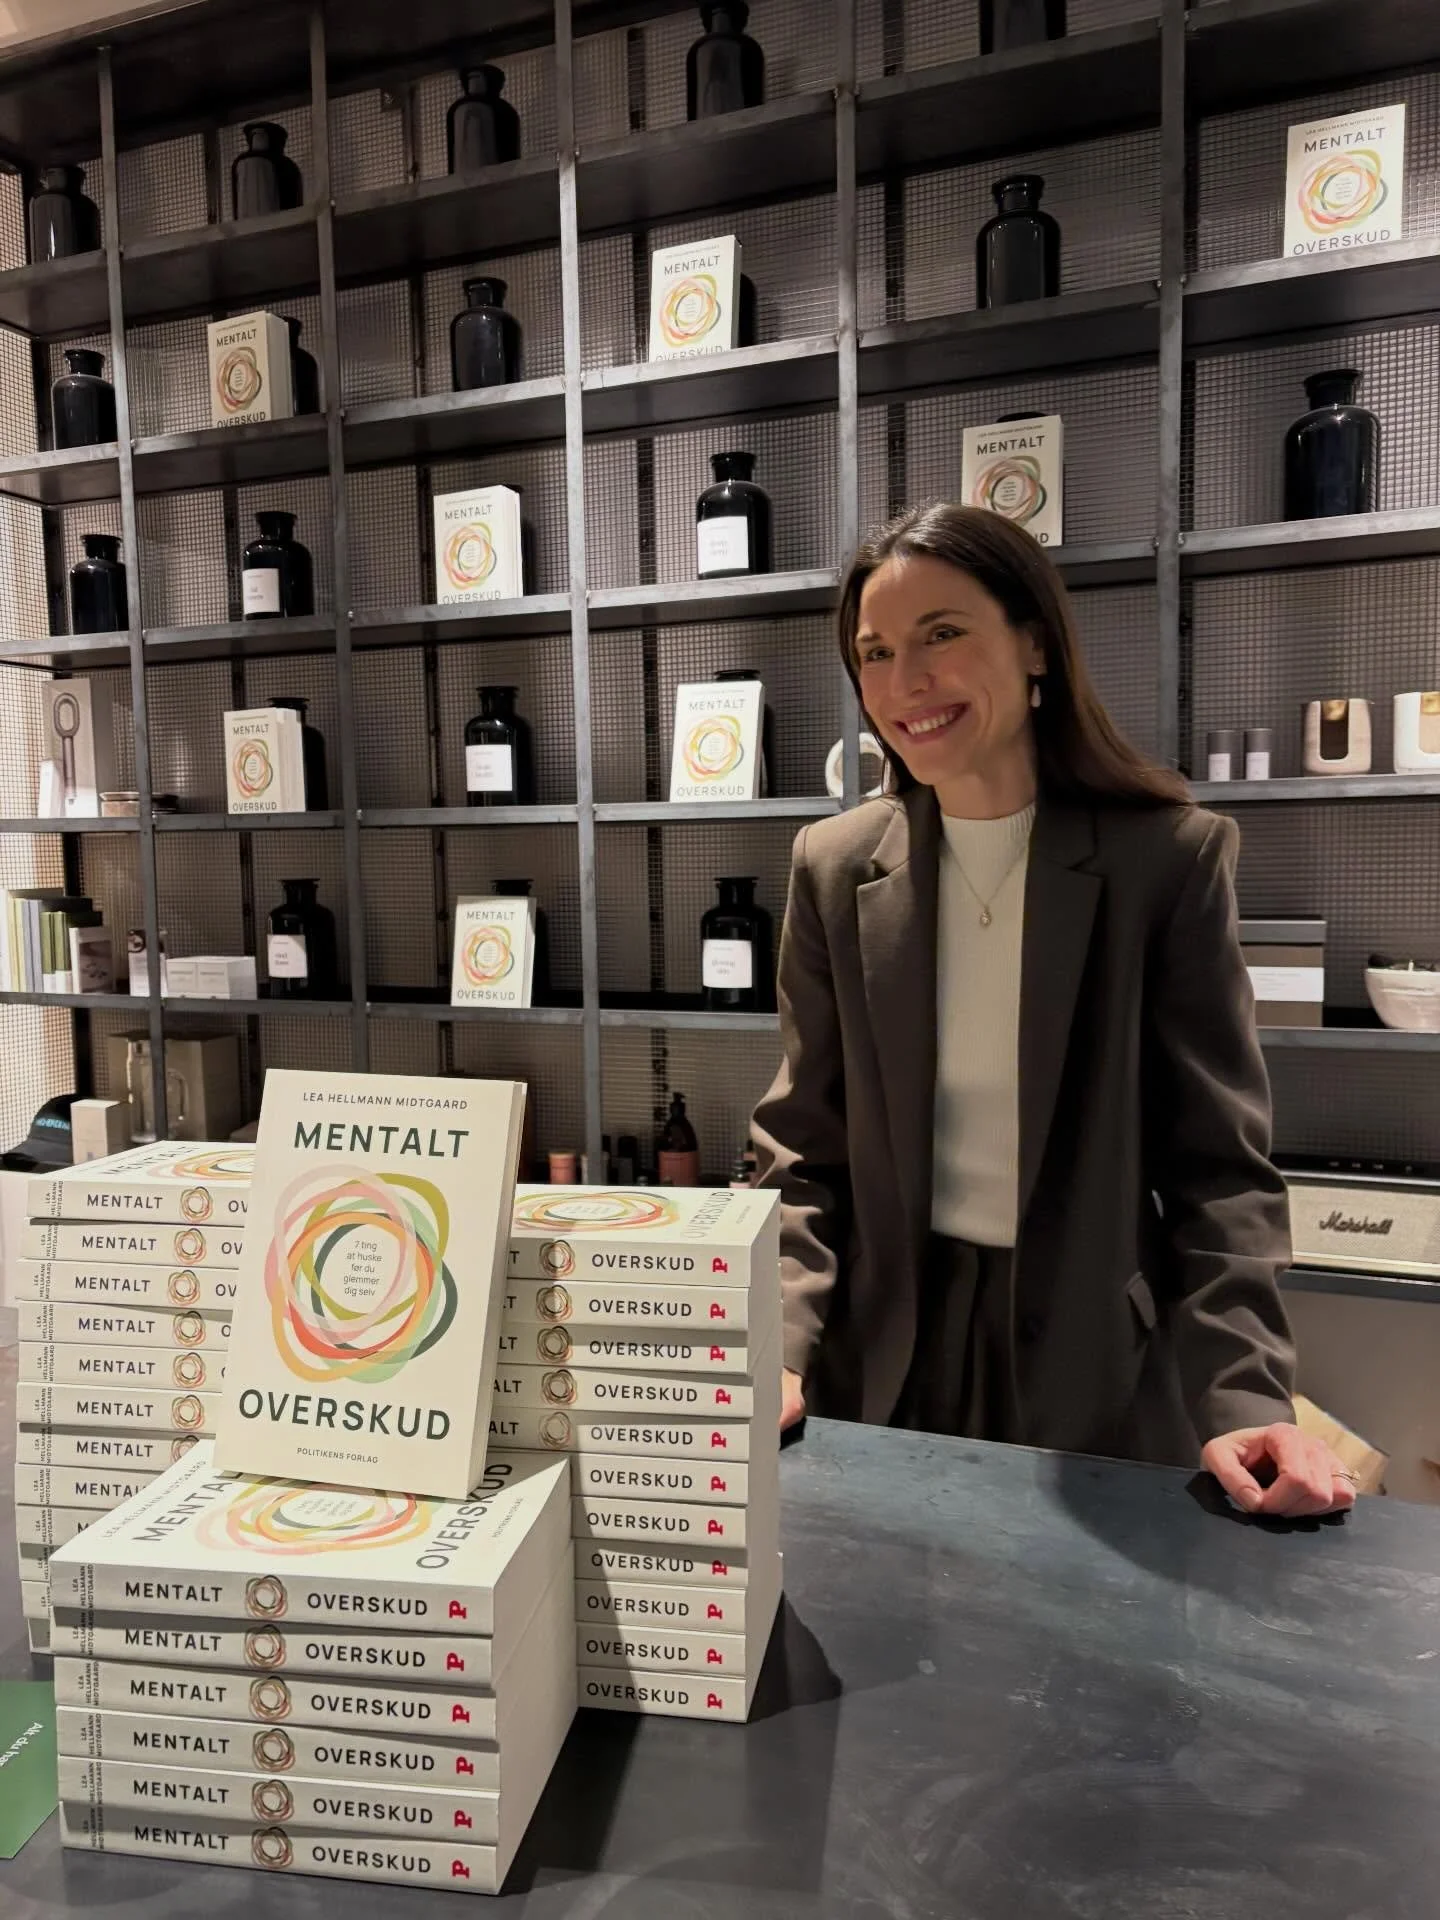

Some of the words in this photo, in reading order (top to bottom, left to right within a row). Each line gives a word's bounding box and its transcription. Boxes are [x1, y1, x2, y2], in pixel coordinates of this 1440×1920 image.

[1304, 128, 1386, 154] MENTALT
[1293, 230, 1391, 256] OVERSKUD
[664, 256, 721, 276] MENTALT
[216, 329, 257, 348] MENTALT
[977, 436, 1045, 456] MENTALT
[445, 504, 493, 521] MENTALT
[689, 698, 746, 711] MENTALT
[233, 724, 269, 735] MENTALT
[676, 786, 745, 797] OVERSKUD
[232, 802, 277, 812] OVERSKUD
[466, 911, 516, 921] MENTALT
[458, 990, 516, 1001] OVERSKUD
[303, 1092, 324, 1102] LEA
[328, 1093, 392, 1106] HELLMANN
[396, 1098, 468, 1110] MIDTGAARD
[294, 1122, 470, 1158] MENTALT
[87, 1194, 163, 1209] MENTALT
[682, 1192, 735, 1238] OVERSKUD
[1319, 1210, 1394, 1235] Marshall
[82, 1236, 157, 1251] MENTALT
[354, 1240, 360, 1249] 7
[362, 1241, 378, 1253] ting
[346, 1252, 356, 1260] at
[358, 1252, 383, 1262] huske
[592, 1254, 695, 1271] OVERSKUD
[352, 1264, 363, 1272] før
[364, 1264, 375, 1273] du
[75, 1276, 151, 1292] MENTALT
[344, 1274, 380, 1285] glemmer
[344, 1287, 357, 1297] dig
[358, 1288, 376, 1297] selv
[589, 1300, 692, 1317] OVERSKUD
[78, 1318, 156, 1333] MENTALT
[589, 1340, 692, 1359] OVERSKUD
[79, 1359, 156, 1375] MENTALT
[594, 1384, 697, 1402] OVERSKUD
[77, 1401, 154, 1417] MENTALT
[239, 1388, 451, 1441] OVERSKUD
[591, 1426, 693, 1445] OVERSKUD
[76, 1440, 153, 1458] MENTALT
[297, 1448, 344, 1460] POLITIKENS
[346, 1453, 379, 1464] FORLAG
[590, 1470, 693, 1489] OVERSKUD
[76, 1482, 145, 1498] MENTA
[132, 1472, 244, 1542] MENTAL
[416, 1464, 513, 1569] OVERSKUD
[587, 1512, 689, 1532] OVERSKUD
[592, 1554, 694, 1573] OVERSKUD
[125, 1582, 223, 1603] MENTALT
[307, 1593, 428, 1616] OVERSKUD
[587, 1596, 689, 1616] OVERSKUD
[125, 1628, 222, 1652] MENTALT
[306, 1644, 426, 1668] OVERSKUD
[586, 1640, 689, 1661] OVERSKUD
[130, 1680, 227, 1703] MENTALT
[311, 1695, 431, 1720] OVERSKUD
[586, 1682, 689, 1705] OVERSKUD
[23, 1722, 44, 1736] Alt
[10, 1737, 29, 1750] du
[134, 1732, 230, 1754] MENTALT
[314, 1747, 435, 1772] OVERSKUD
[134, 1780, 229, 1804] MENTALT
[313, 1798, 433, 1824] OVERSKUD
[135, 1826, 229, 1851] MENTALT
[312, 1846, 431, 1874] OVERSKUD
